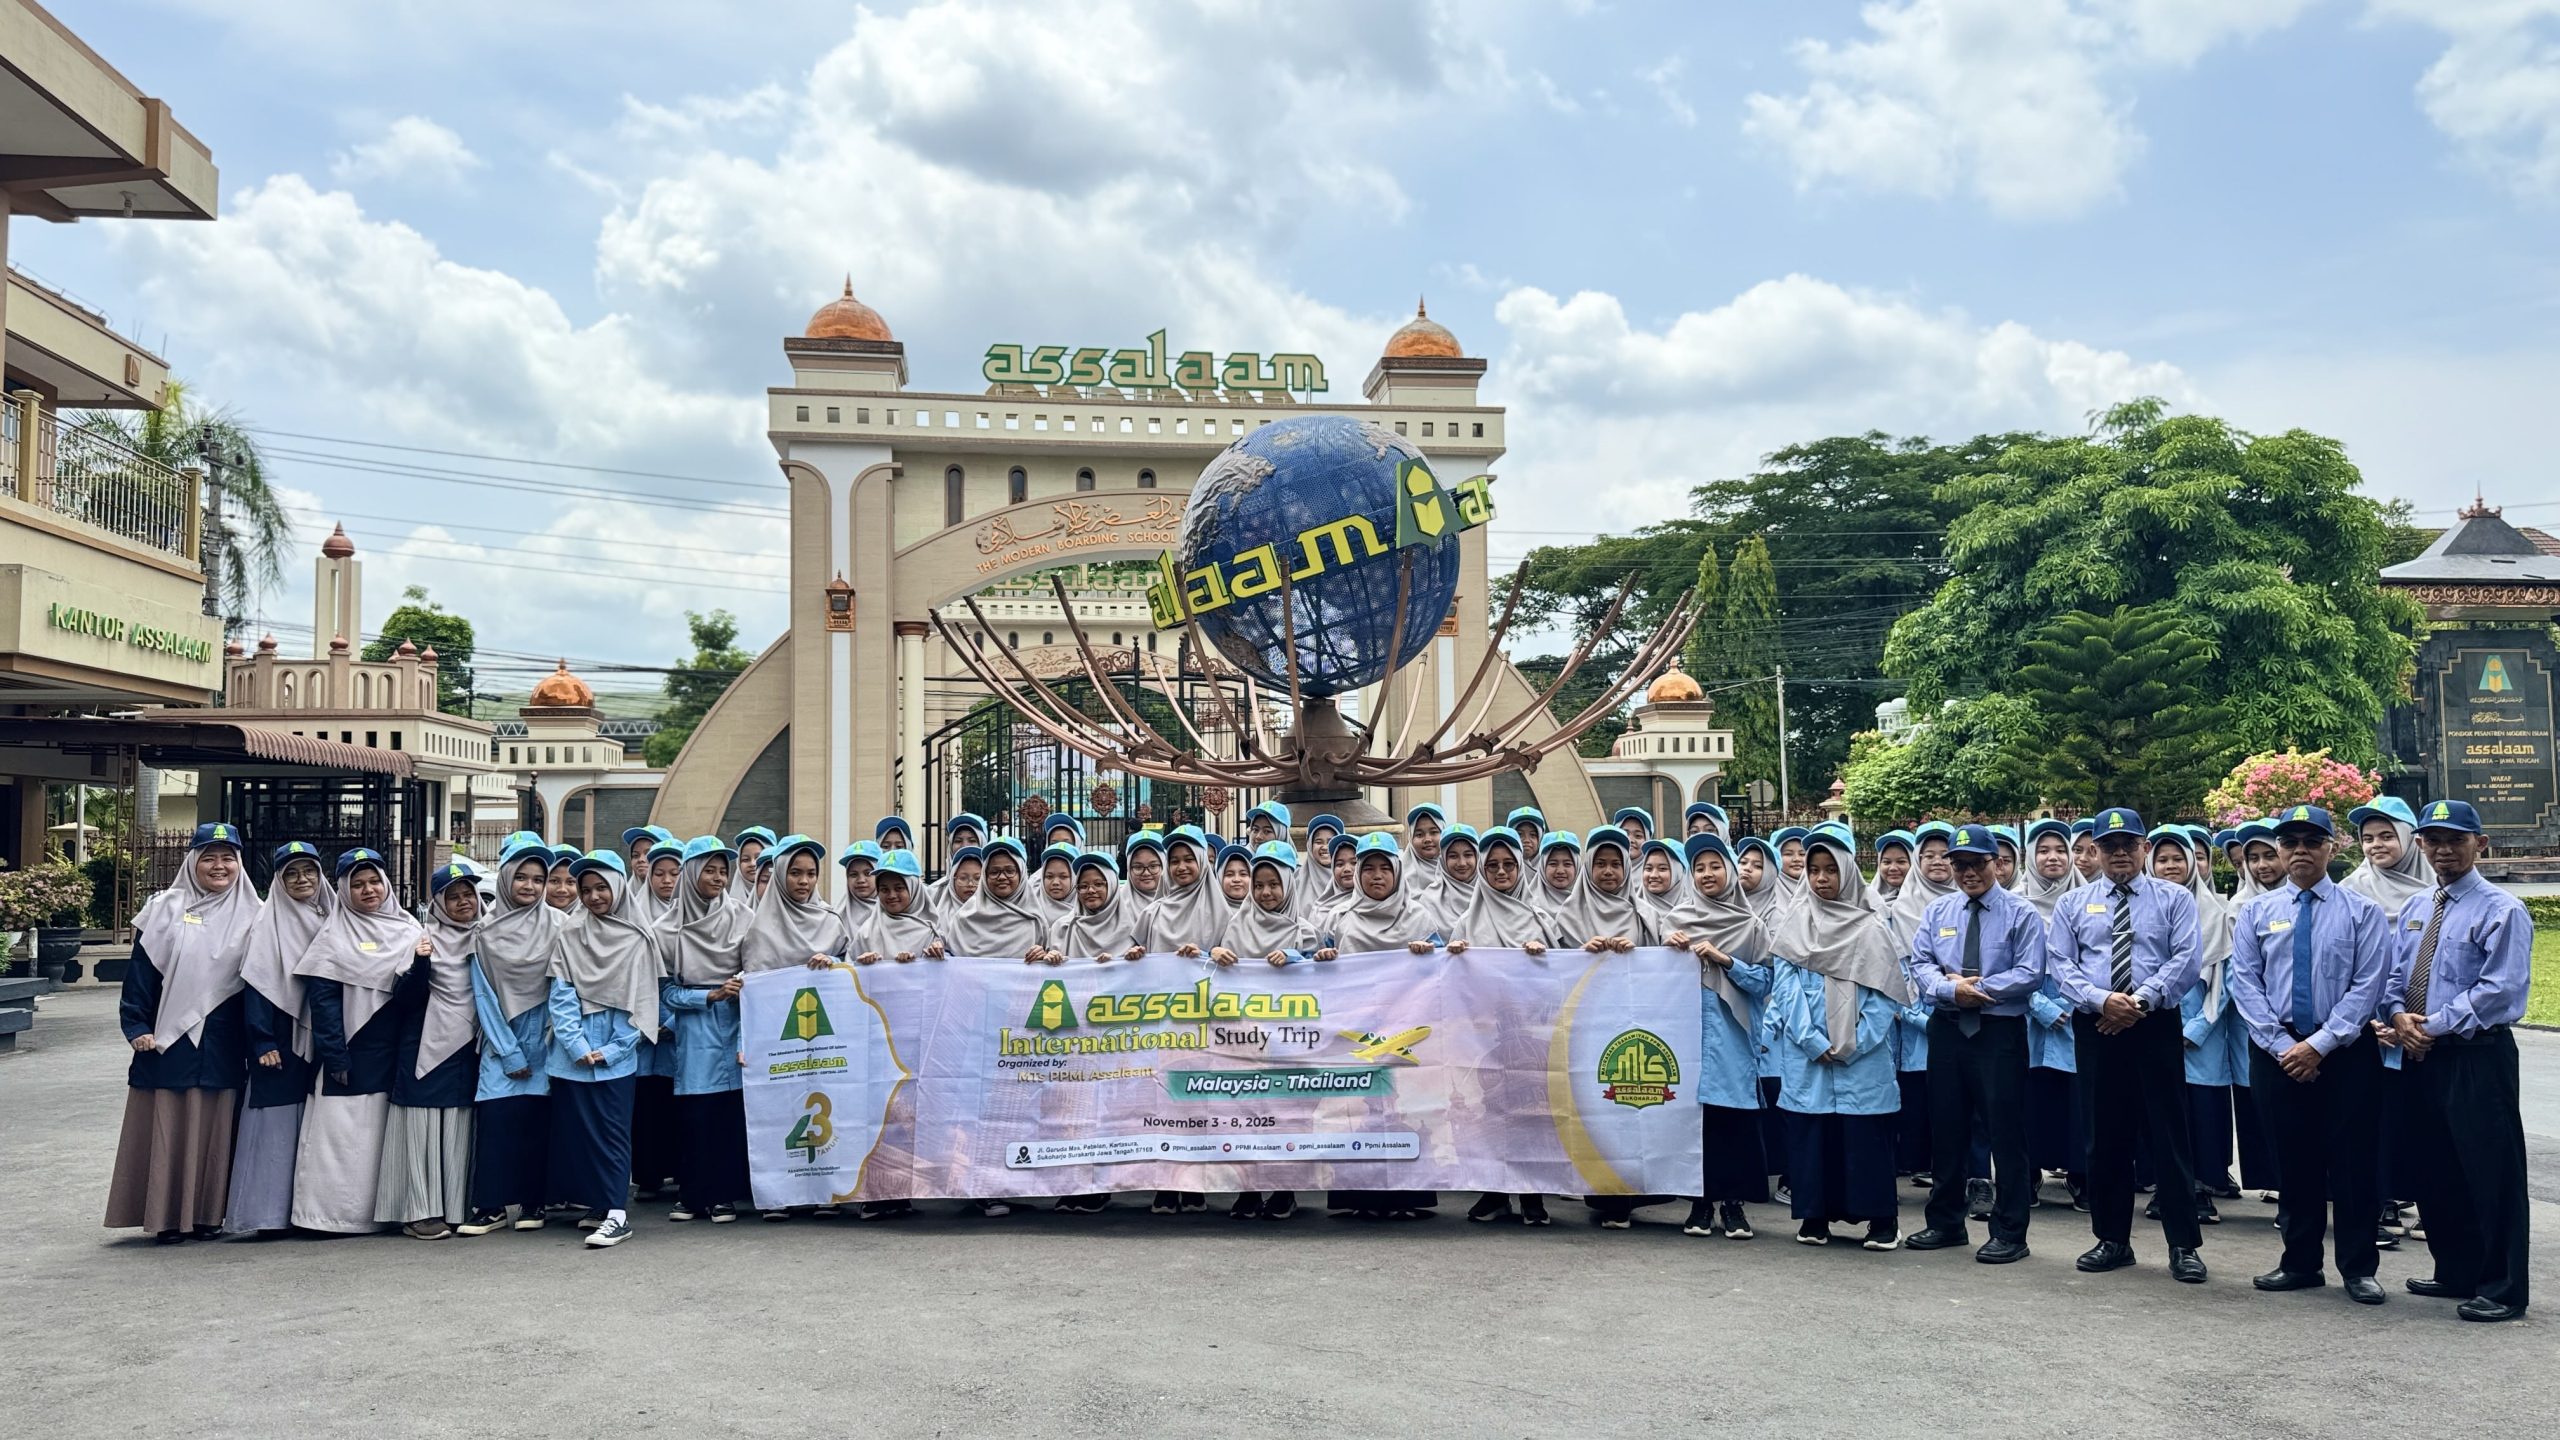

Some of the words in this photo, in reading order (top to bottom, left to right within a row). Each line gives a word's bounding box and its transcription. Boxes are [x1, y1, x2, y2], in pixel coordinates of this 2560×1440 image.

[983, 328, 1328, 391] assalaam
[976, 558, 998, 575] THE
[1001, 542, 1051, 566] MODERN
[1057, 532, 1120, 550] BOARDING
[1128, 531, 1176, 543] SCHOOL
[49, 602, 125, 642] KANTOR
[130, 622, 212, 663] ASSALAAM
[2466, 740, 2535, 755] assalaam
[1086, 977, 1321, 1024] assalaam
[1000, 1023, 1210, 1056] International
[1214, 1027, 1271, 1050] Study
[1278, 1025, 1321, 1050] Trip
[769, 1054, 848, 1074] assalaam
[997, 1058, 1050, 1070] Organized
[1052, 1058, 1067, 1070] by:
[1018, 1071, 1045, 1082] MTs
[1048, 1070, 1085, 1082] PPMI
[1089, 1067, 1154, 1081] Assalaam
[1186, 1075, 1270, 1095] Malaysia
[1287, 1072, 1372, 1090] Thailand
[1615, 1087, 1664, 1095] assalaam
[1143, 1117, 1208, 1128] November
[1211, 1117, 1219, 1128] 3
[1230, 1117, 1242, 1129] 8,
[1246, 1116, 1276, 1127] 2025
[816, 1135, 840, 1156] TAHUN
[1298, 1142, 1345, 1151] ppmi_assalaam
[1365, 1142, 1380, 1150] Ppmi
[1382, 1141, 1411, 1149] Assalaam
